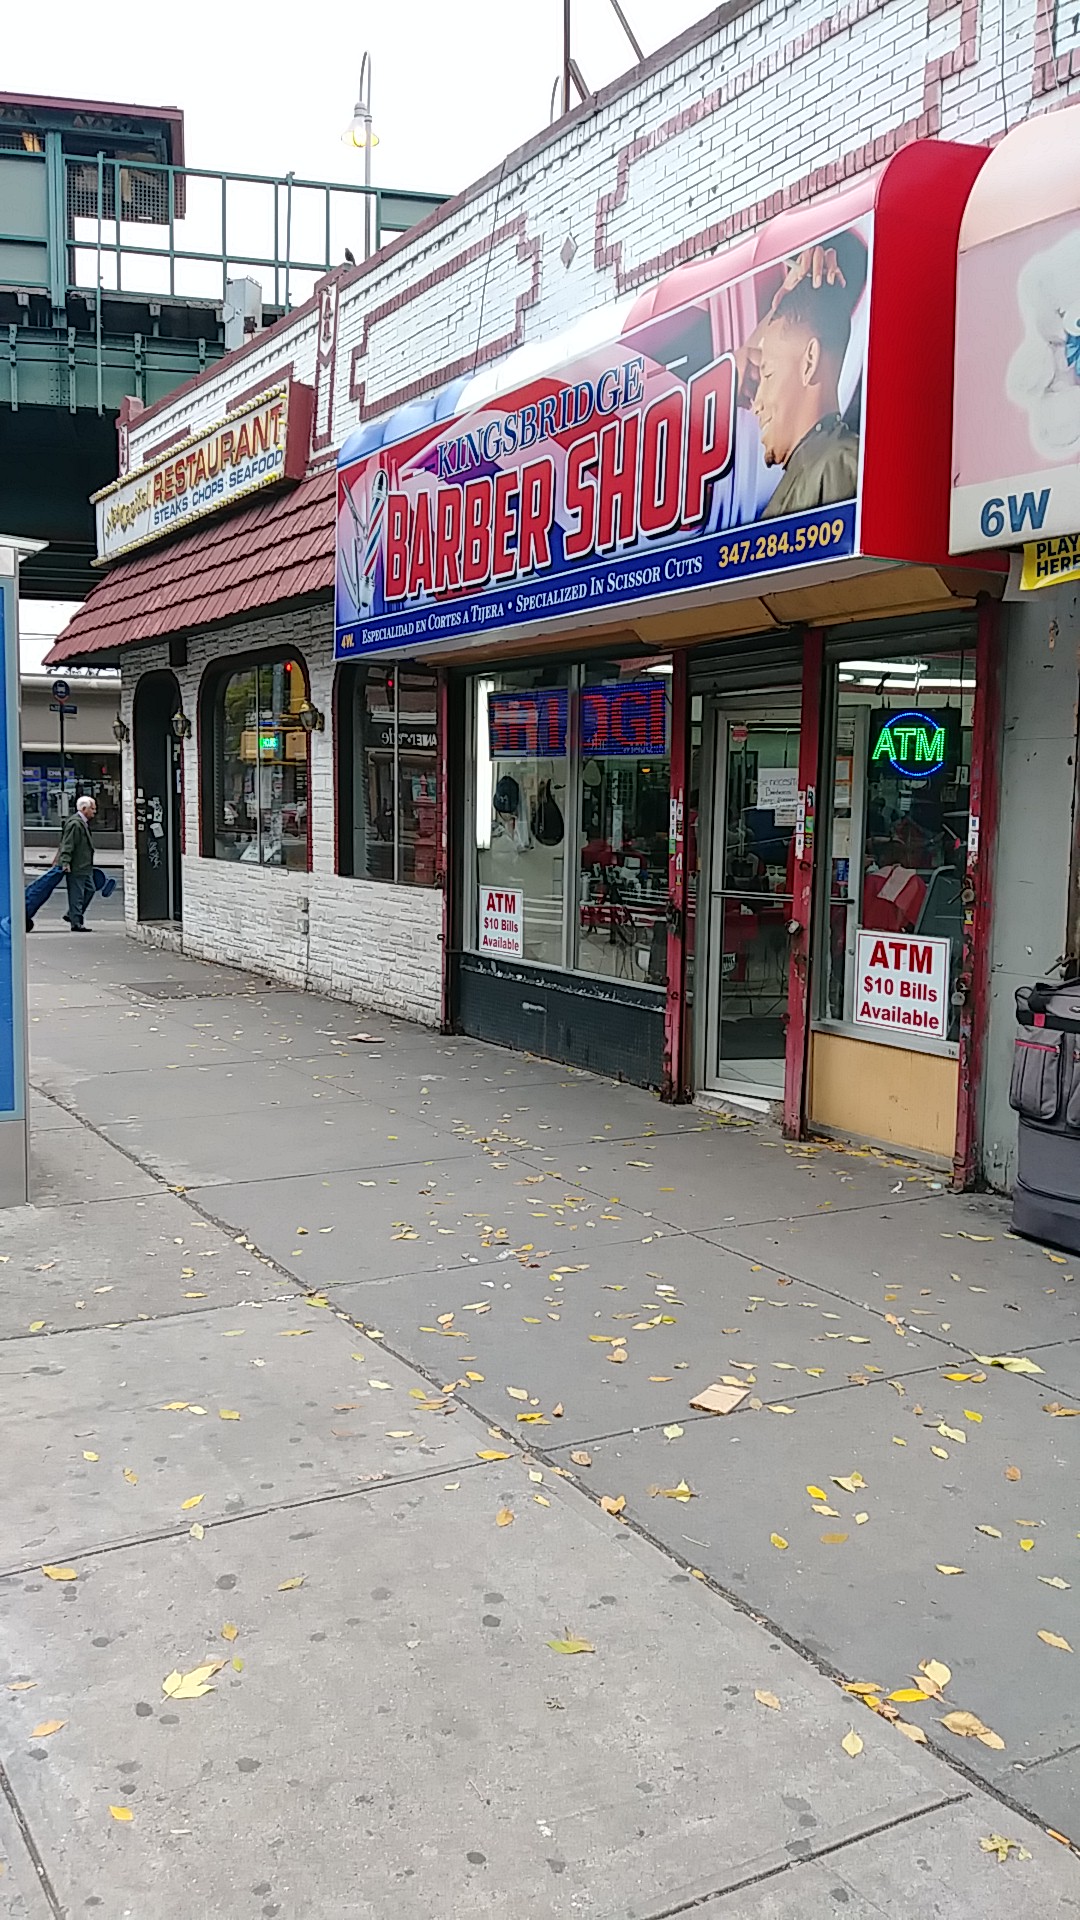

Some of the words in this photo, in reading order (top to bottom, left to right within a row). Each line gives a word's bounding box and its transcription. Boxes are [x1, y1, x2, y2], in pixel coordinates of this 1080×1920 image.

[437, 356, 644, 480] KINGSBRIDGE
[152, 403, 284, 508] RESTAURANT
[153, 496, 188, 526] STEAKS
[192, 478, 224, 507] CHOPS
[229, 450, 283, 489] SEAFOOD
[384, 454, 555, 602] BARBER
[563, 352, 737, 561] SHOP
[980, 487, 1052, 538] 6W
[718, 519, 844, 568] 347.284.5909
[1036, 534, 1080, 560] PLAY
[1036, 553, 1080, 578] HERE
[515, 582, 587, 613] SPECIALIZED
[589, 577, 605, 596] IN
[606, 566, 661, 593] SCISSOR
[664, 555, 703, 580] CUTS
[361, 620, 414, 645] ESPECIALIDAD
[416, 618, 427, 634] EN
[427, 610, 461, 632] CORTES
[462, 612, 469, 623] A
[470, 600, 505, 624] TIJERA
[872, 727, 945, 761] ATM
[486, 892, 516, 914] ATM
[484, 916, 499, 930] $10
[501, 919, 519, 933] Bills
[482, 934, 519, 951] Available
[868, 940, 933, 975] ATM
[863, 975, 894, 995] $10
[900, 980, 938, 1002] Bills
[860, 1001, 940, 1030] Available
